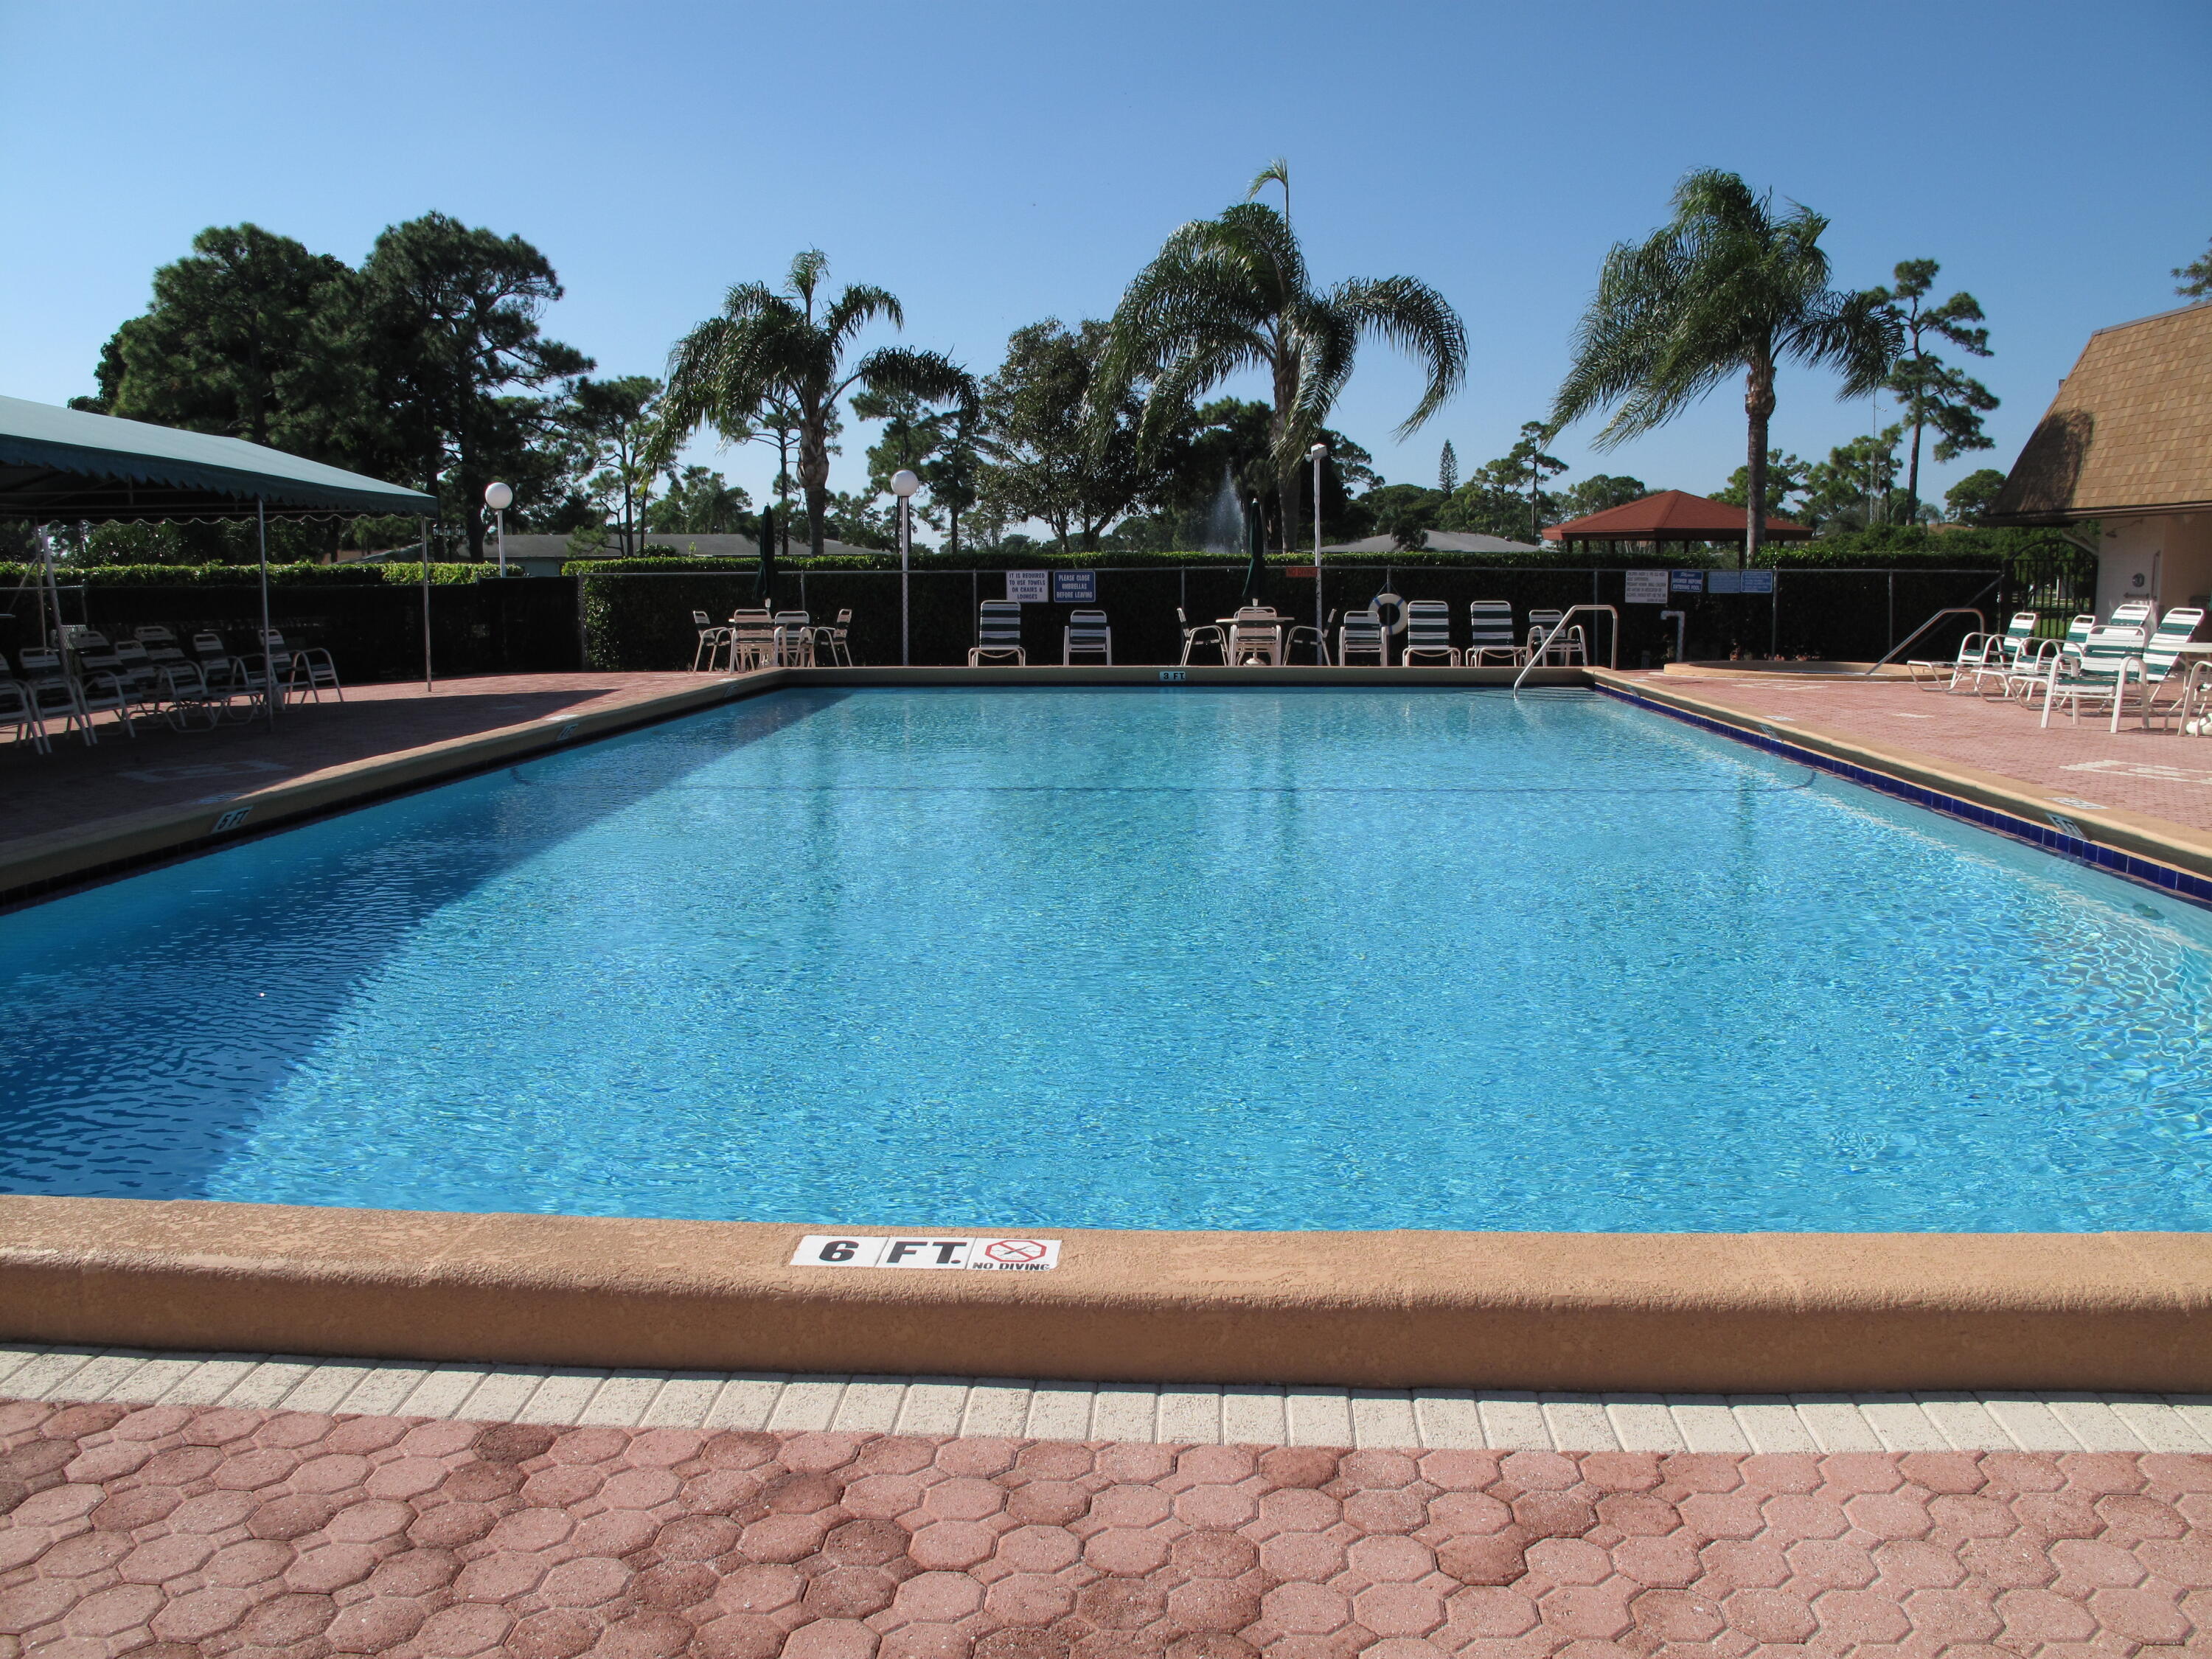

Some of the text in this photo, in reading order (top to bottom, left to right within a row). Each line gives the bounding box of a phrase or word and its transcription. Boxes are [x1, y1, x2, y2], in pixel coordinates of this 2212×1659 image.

[218, 814, 232, 830] 5
[818, 1240, 967, 1264] 6 FT.
